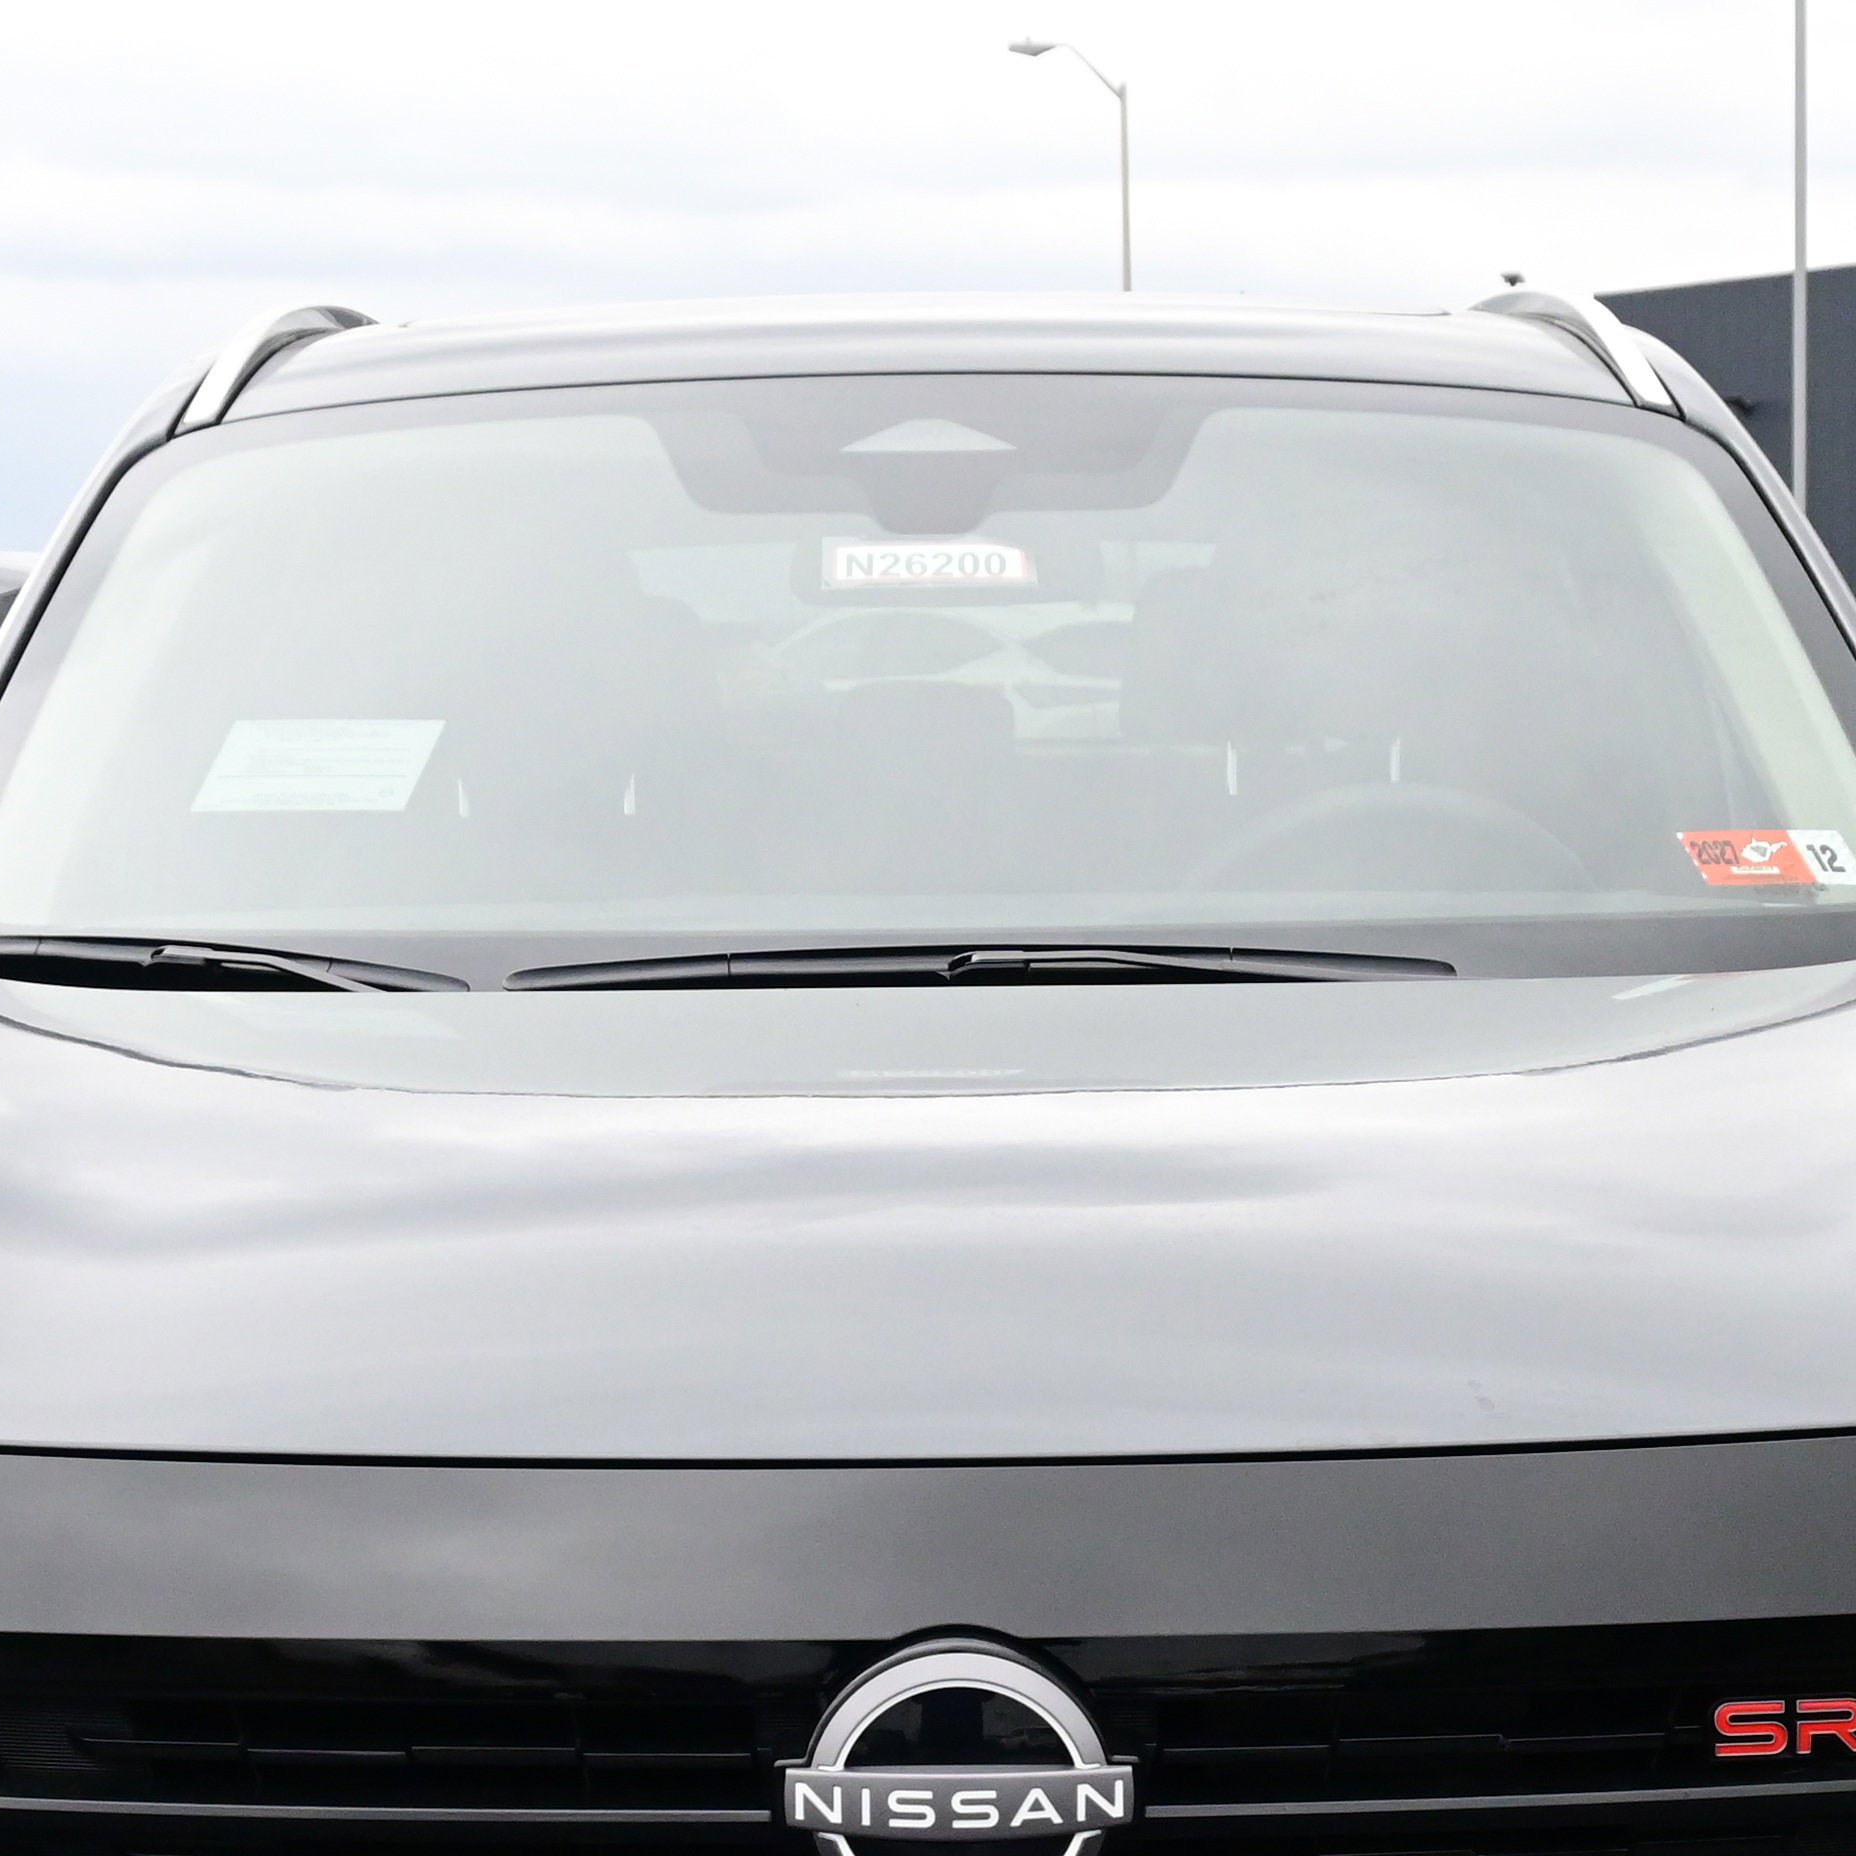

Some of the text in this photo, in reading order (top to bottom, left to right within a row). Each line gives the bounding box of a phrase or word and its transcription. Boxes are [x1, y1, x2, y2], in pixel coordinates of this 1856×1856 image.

[846, 552, 1006, 578] N26200
[1806, 844, 1846, 872] 12
[794, 1779, 1125, 1829] NISSAN
